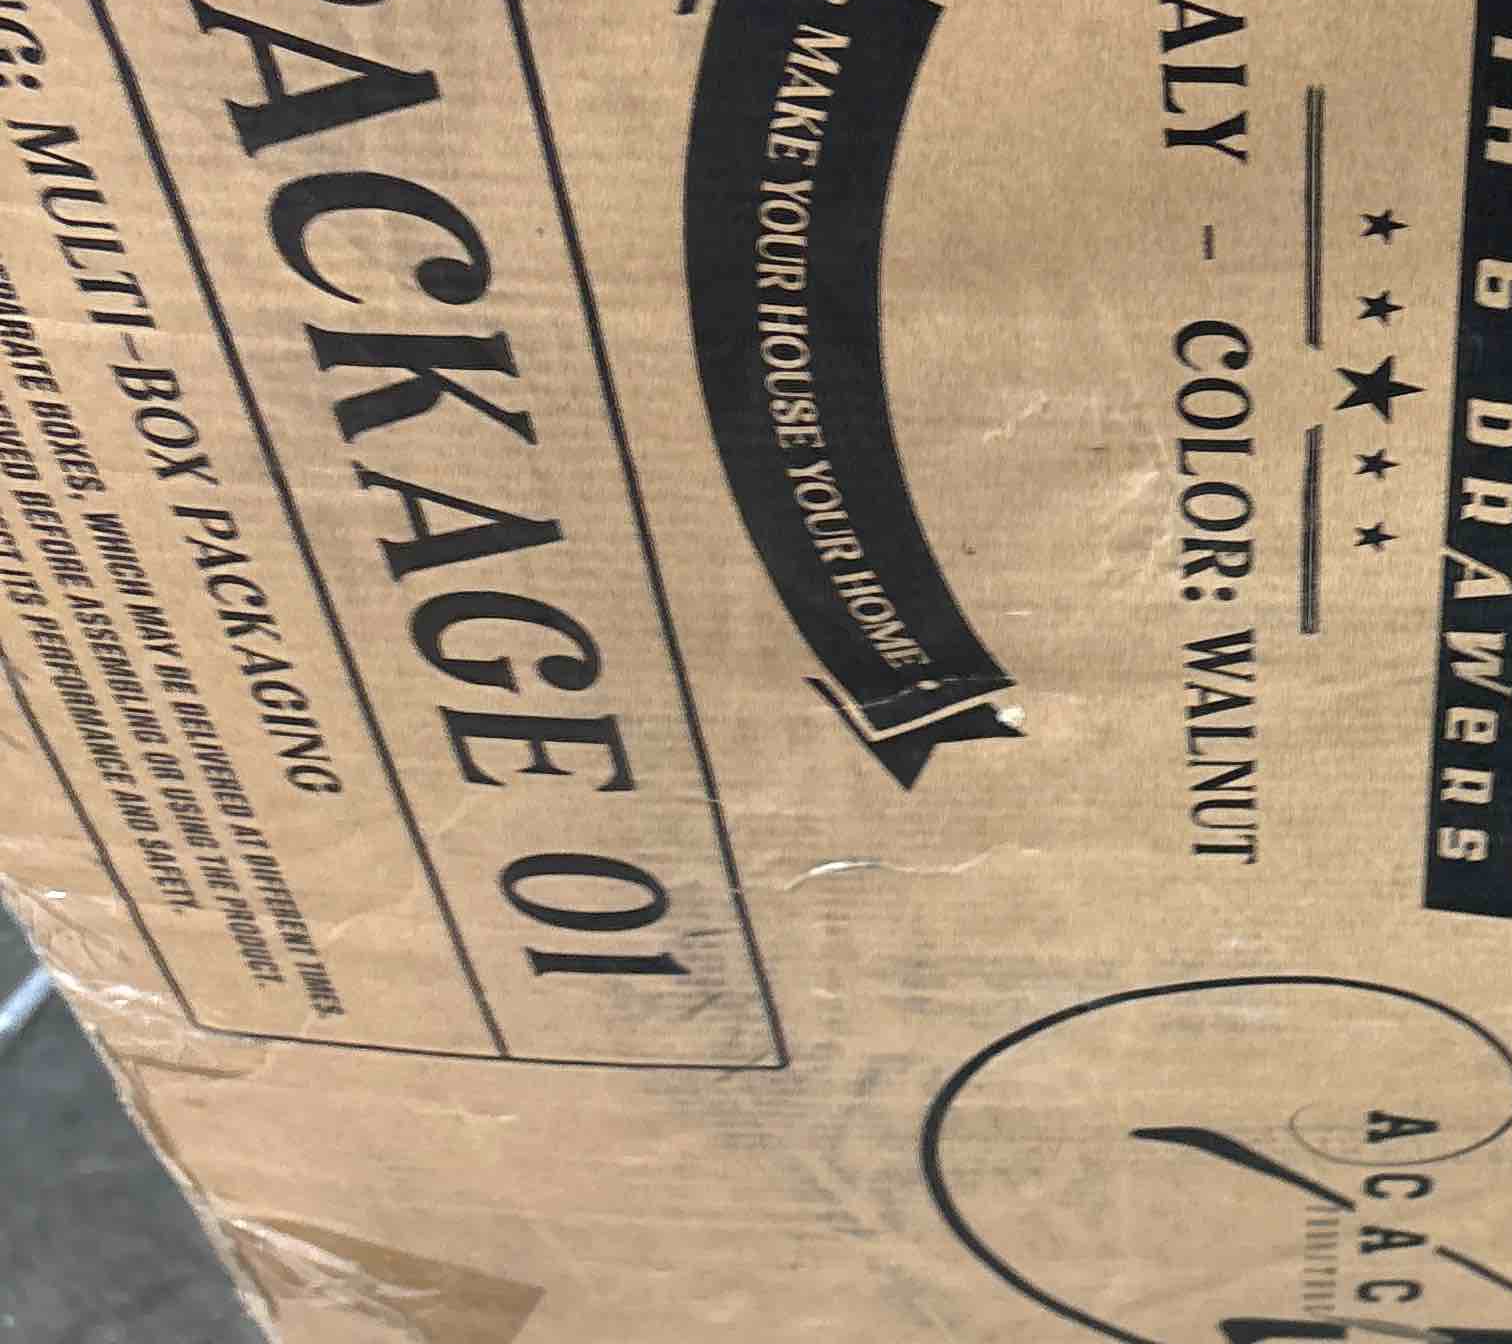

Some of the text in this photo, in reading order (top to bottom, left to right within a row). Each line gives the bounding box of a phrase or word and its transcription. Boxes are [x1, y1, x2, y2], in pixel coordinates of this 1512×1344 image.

[755, 23, 931, 670] MAKE YOUR HOUSE YOUR HOME
[6, 119, 345, 795] MULTI-BOX PACKAGING
[27, 399, 107, 499] BOXES,
[1174, 318, 1256, 604] COLOR:
[9, 488, 97, 590] BEFORE
[81, 512, 156, 598] WHICH
[63, 593, 170, 746] ASSEMBLING
[126, 603, 183, 661] MAY
[153, 663, 198, 696] BE
[21, 613, 138, 789] PERFORMANCE
[111, 787, 161, 833] AND
[141, 751, 187, 788] OR
[171, 699, 255, 819] DELIVERED
[1181, 627, 1260, 867] WALNUT
[160, 786, 222, 851] USING
[229, 823, 272, 851] AT
[196, 855, 242, 891] THE
[241, 853, 318, 963] DIFFERENT
[497, 851, 693, 977] 01
